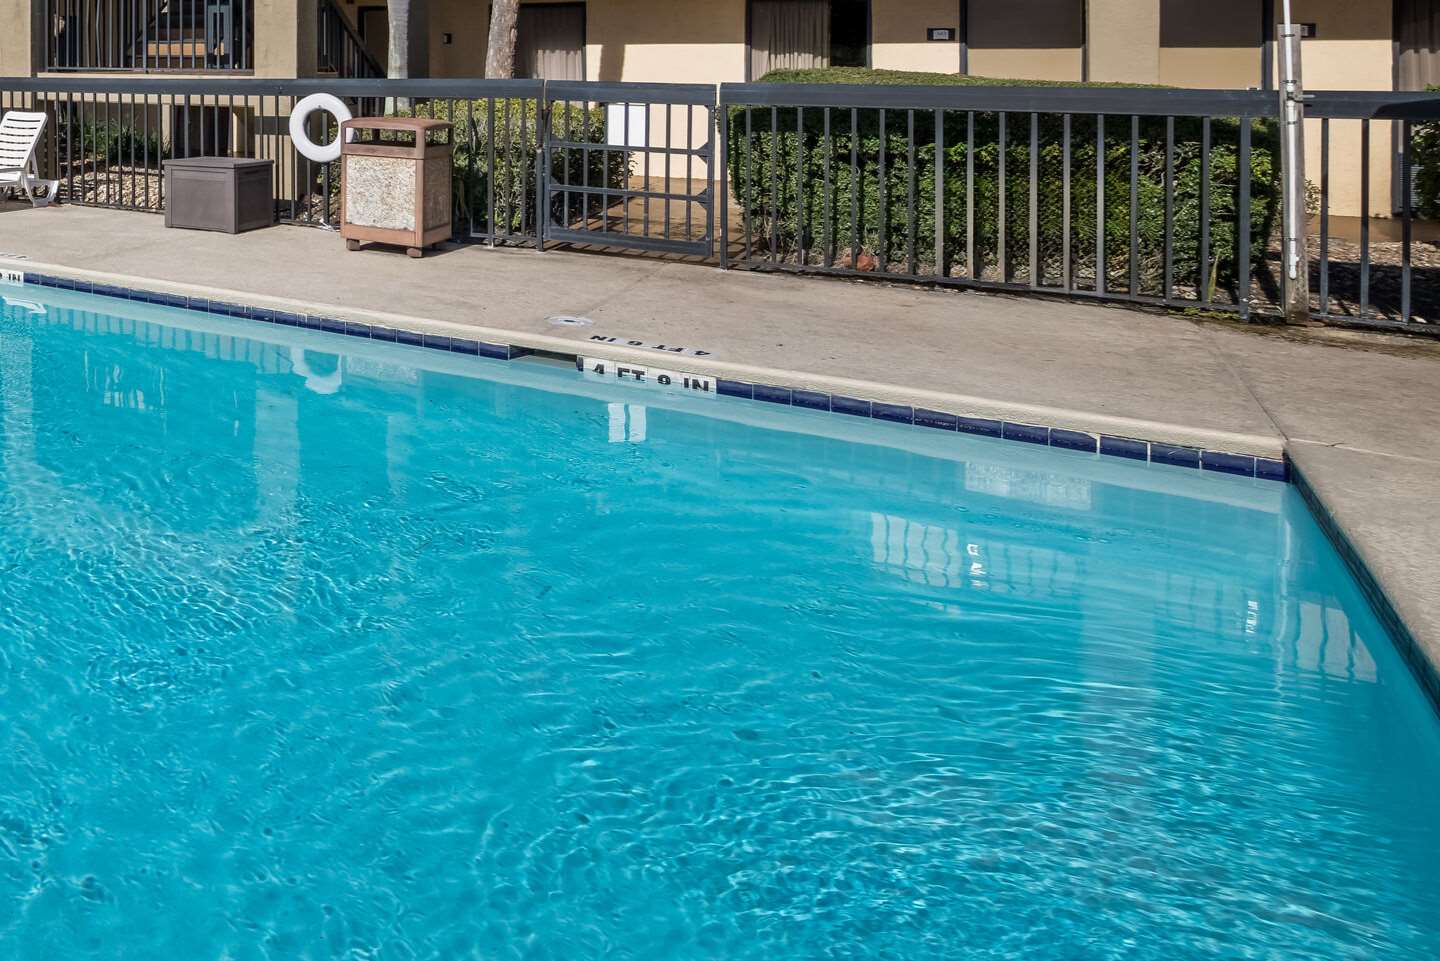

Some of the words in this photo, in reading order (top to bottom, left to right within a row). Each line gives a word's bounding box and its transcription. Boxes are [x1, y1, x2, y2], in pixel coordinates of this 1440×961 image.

[8, 273, 21, 282] IN
[592, 363, 605, 374] 4
[617, 367, 646, 381] FT
[683, 377, 709, 392] IN
